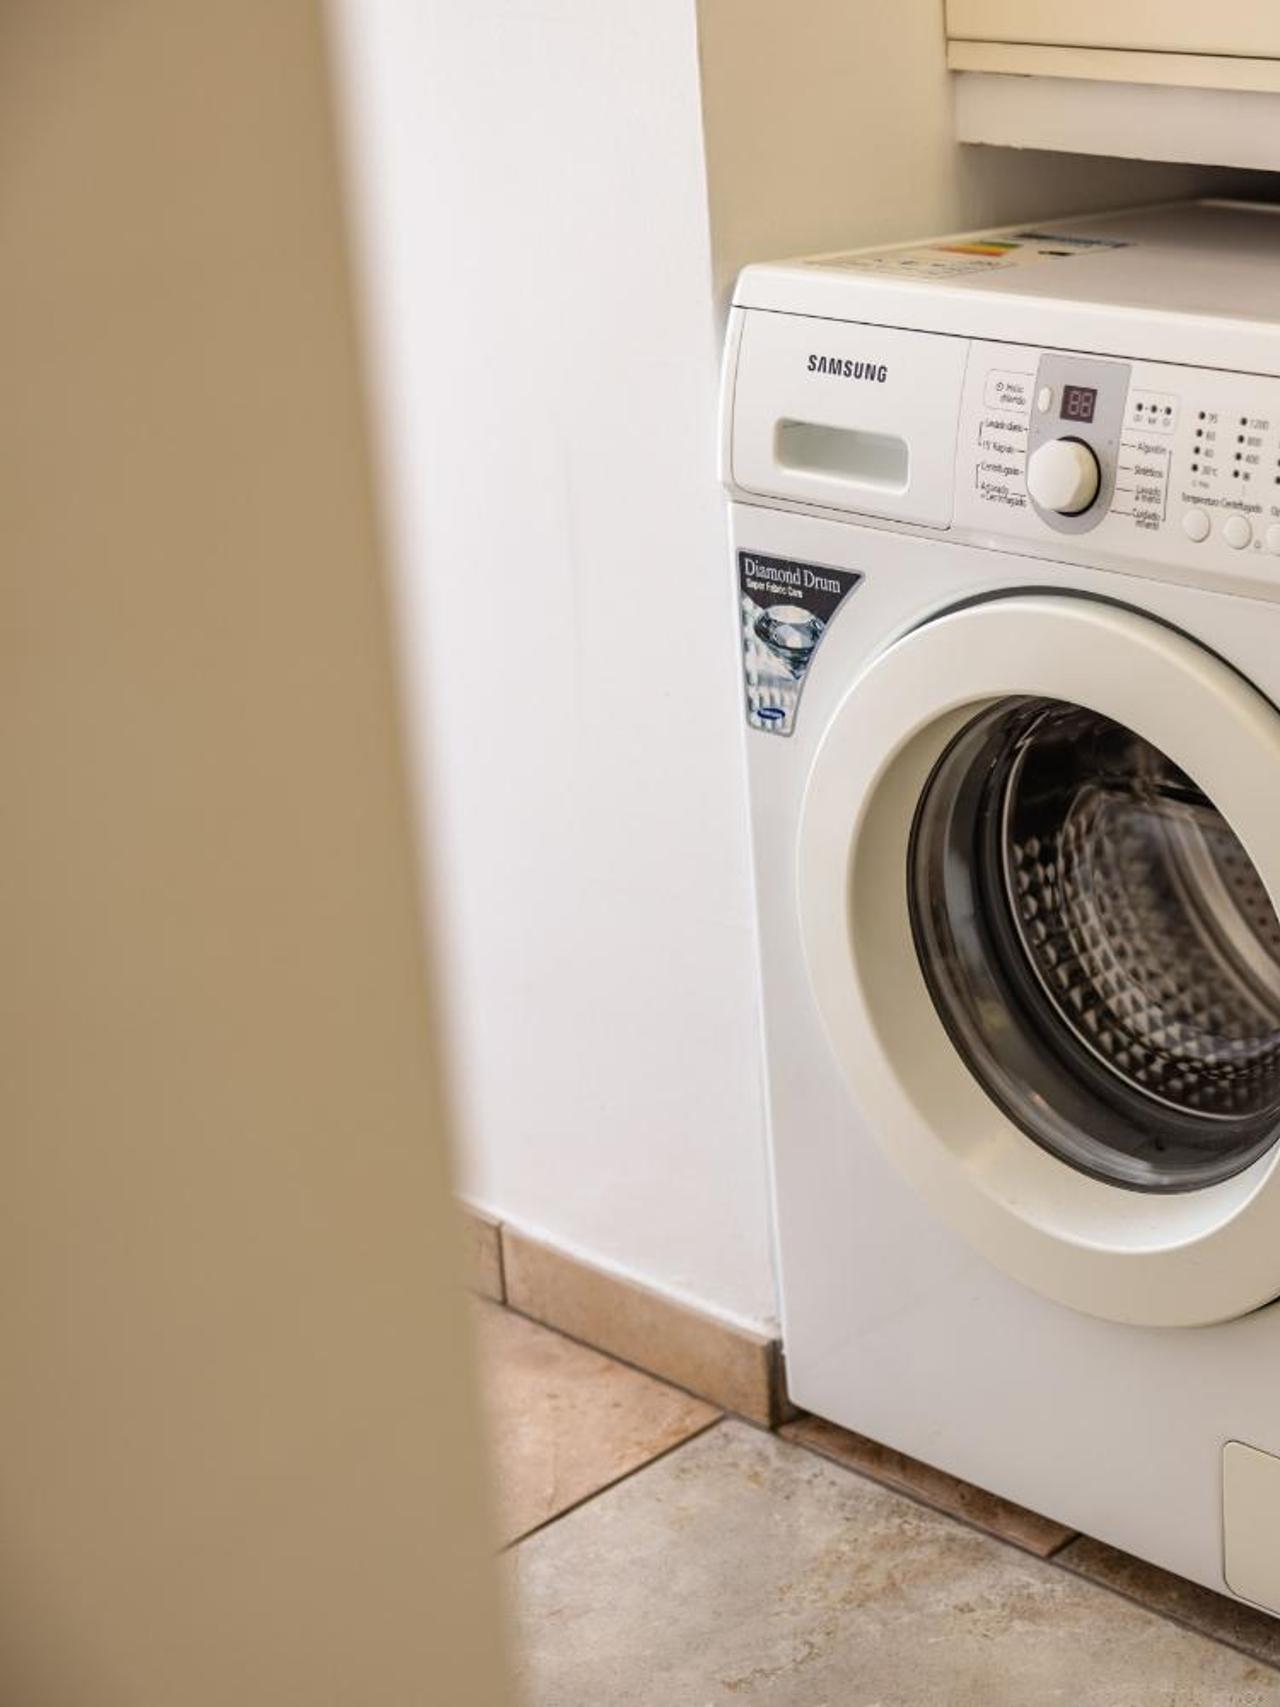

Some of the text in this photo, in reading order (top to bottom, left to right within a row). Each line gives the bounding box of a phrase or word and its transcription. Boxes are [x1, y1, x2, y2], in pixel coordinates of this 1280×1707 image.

[807, 354, 888, 383] SAMSUNG
[744, 557, 842, 594] Diamond Drum
[746, 578, 804, 599] Super Fabric Care
